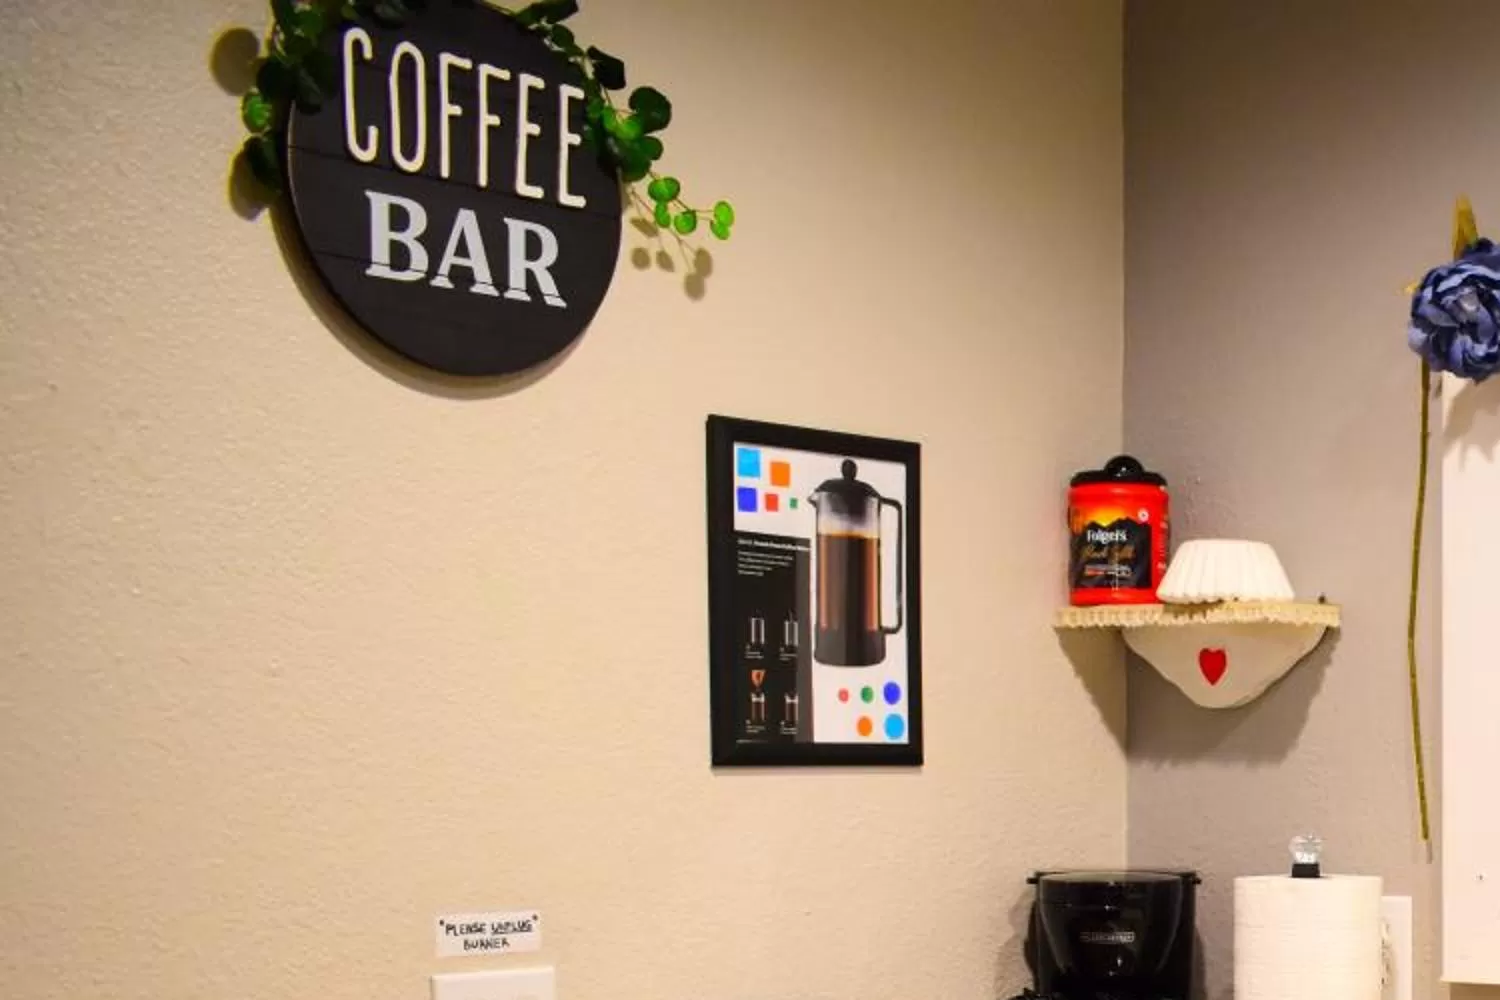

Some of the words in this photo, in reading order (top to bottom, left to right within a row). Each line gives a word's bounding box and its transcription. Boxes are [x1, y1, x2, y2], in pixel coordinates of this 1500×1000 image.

[343, 26, 588, 210] COFFEE
[364, 188, 568, 309] BAR
[445, 921, 486, 937] PLEASE
[491, 919, 533, 935] UNPLUG
[463, 937, 510, 951] BURNER
